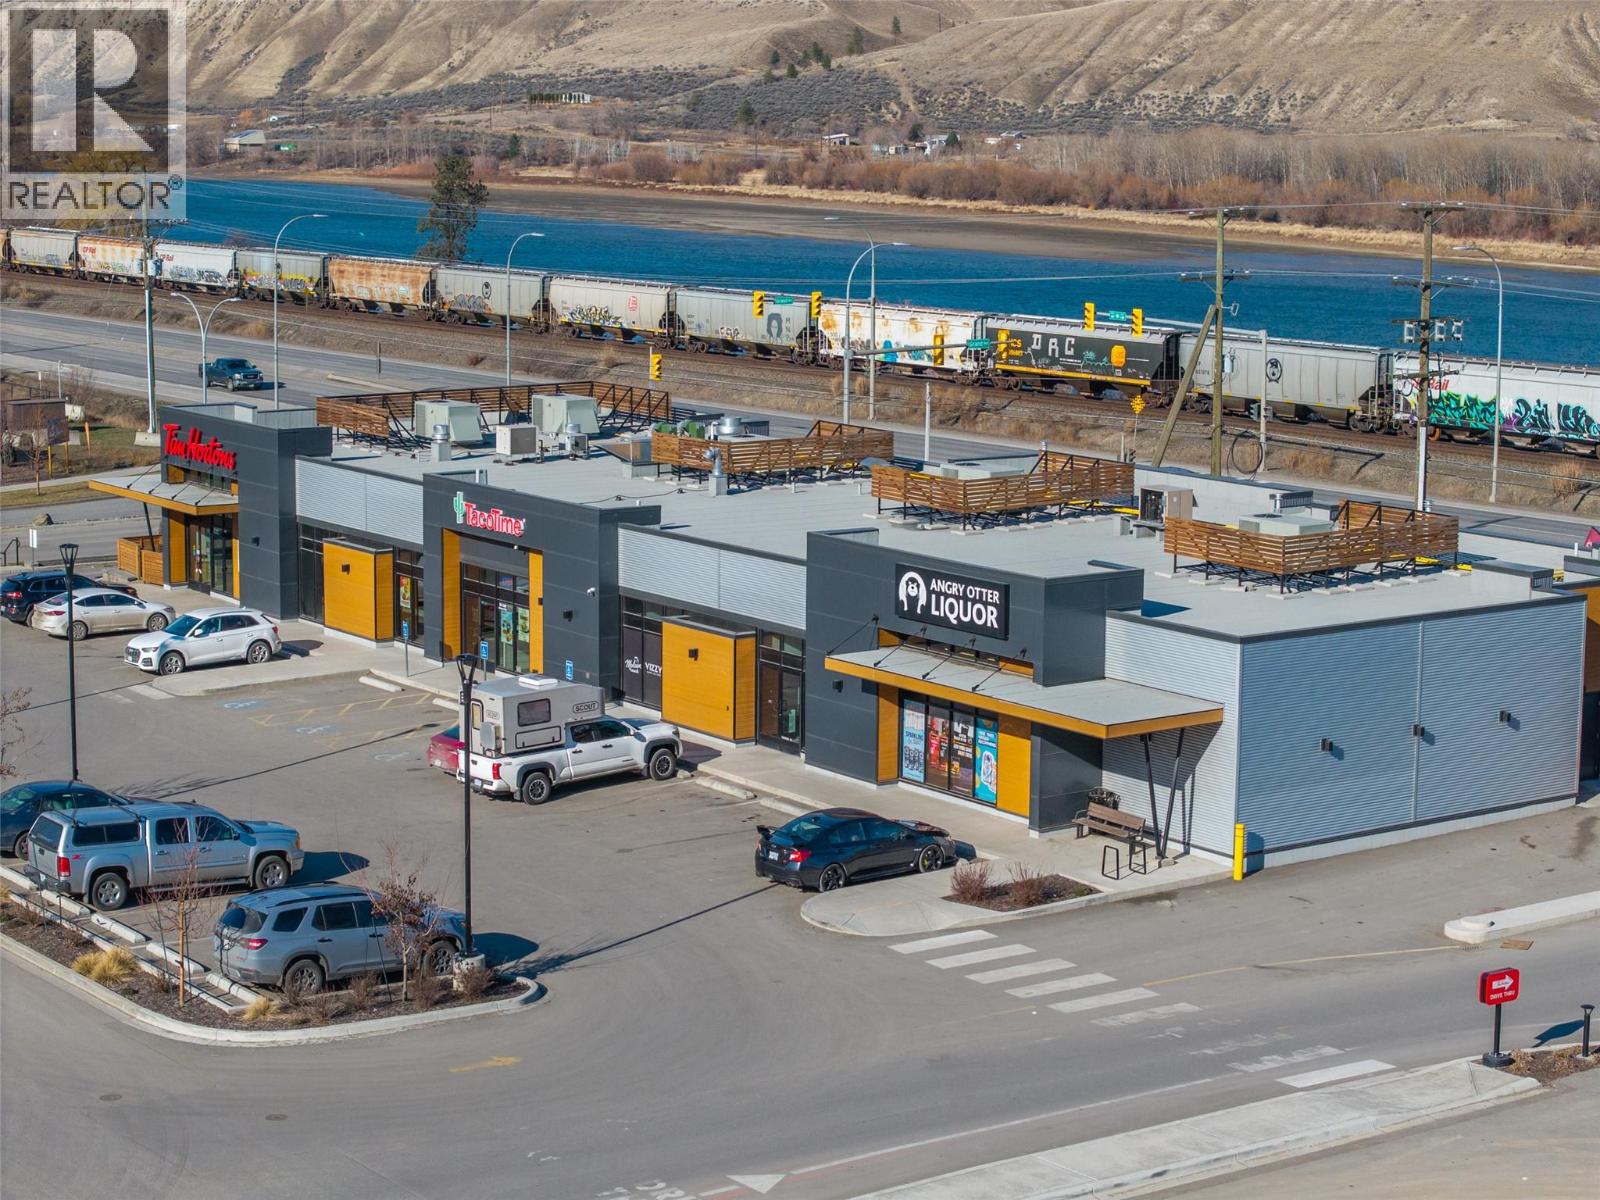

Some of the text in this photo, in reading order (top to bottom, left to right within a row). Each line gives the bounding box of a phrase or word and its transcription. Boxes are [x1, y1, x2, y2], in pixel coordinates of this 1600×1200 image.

[163, 424, 236, 470] Tim Hortons
[464, 501, 524, 537] TacoTime
[930, 578, 999, 604] ANGRY OTTER
[931, 594, 999, 628] LIQUOR
[645, 661, 662, 674] VIZZY
[575, 702, 596, 712] SCOUT
[1490, 992, 1503, 1000] DRIVE
